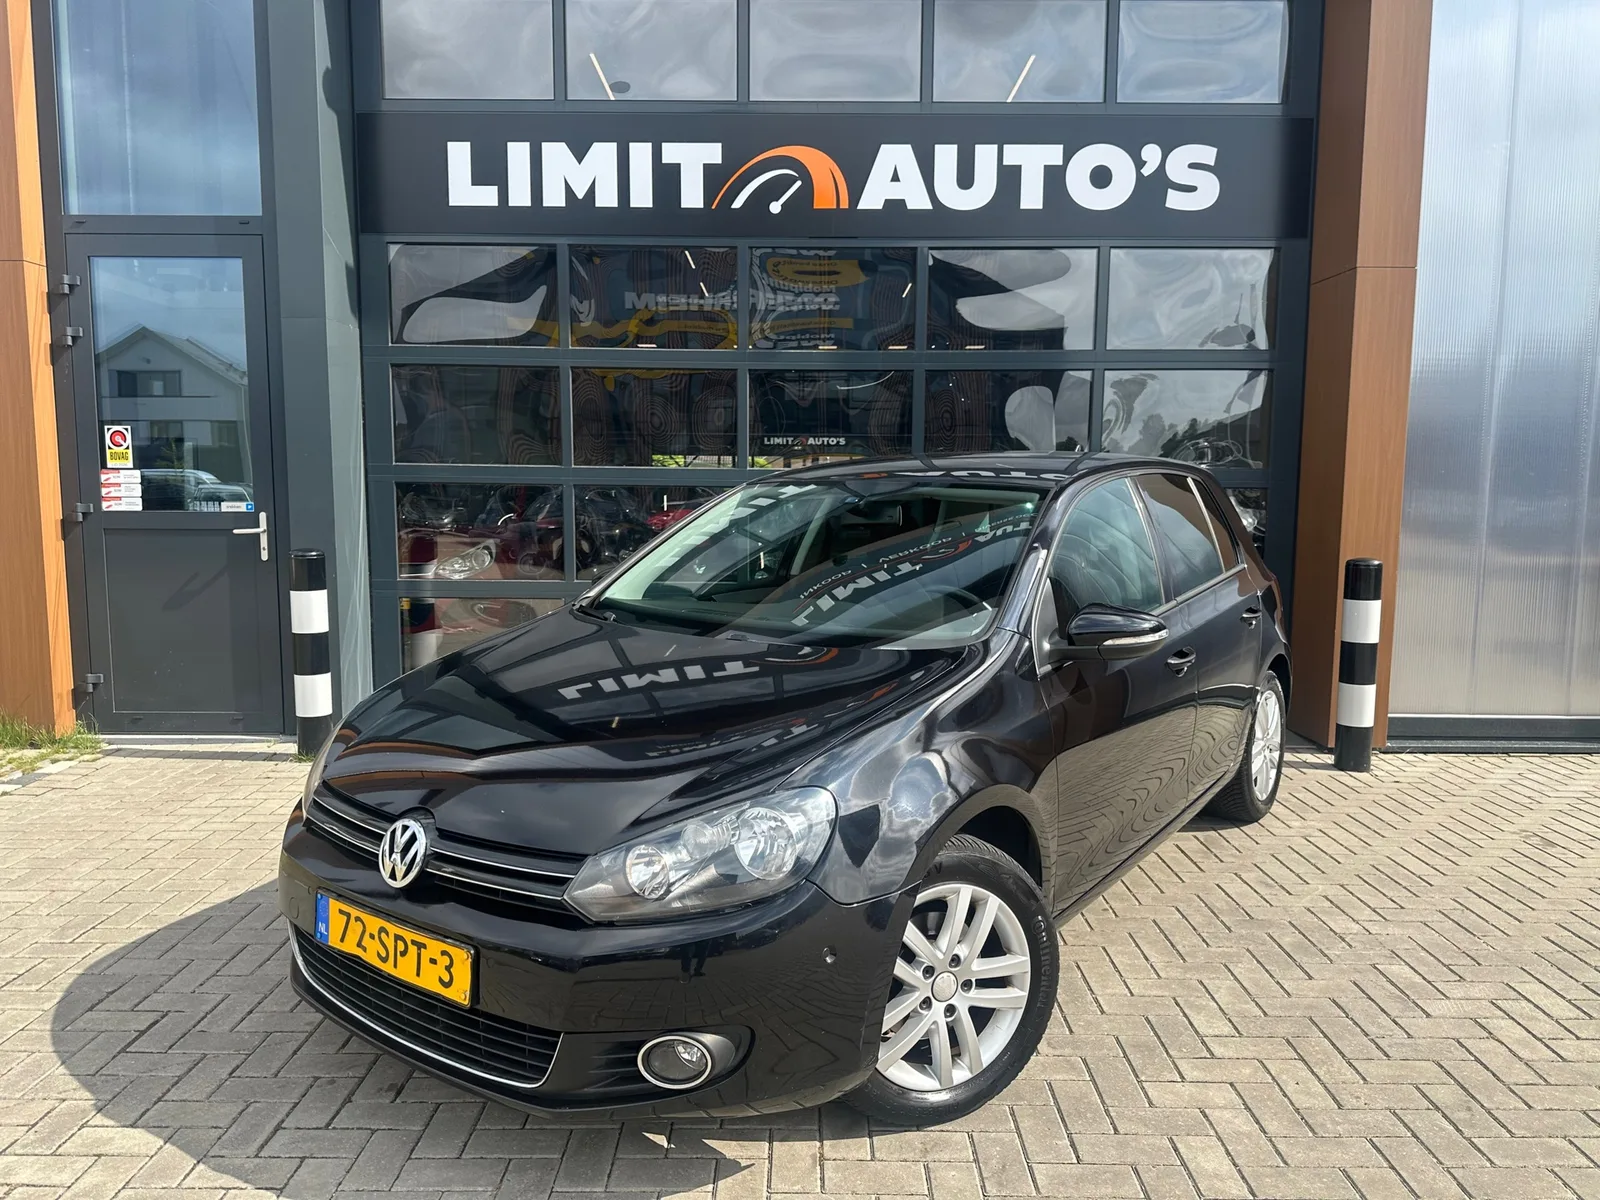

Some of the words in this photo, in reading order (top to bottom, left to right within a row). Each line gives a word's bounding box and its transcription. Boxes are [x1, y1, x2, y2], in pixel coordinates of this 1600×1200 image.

[447, 141, 722, 208] LIMIT
[857, 143, 1220, 211] AUTO'S
[764, 437, 794, 445] LIMIT
[807, 437, 846, 445] AUTO'S
[110, 451, 129, 461] BOVAG
[318, 921, 328, 935] NL
[338, 908, 454, 989] 72-SPT-3
